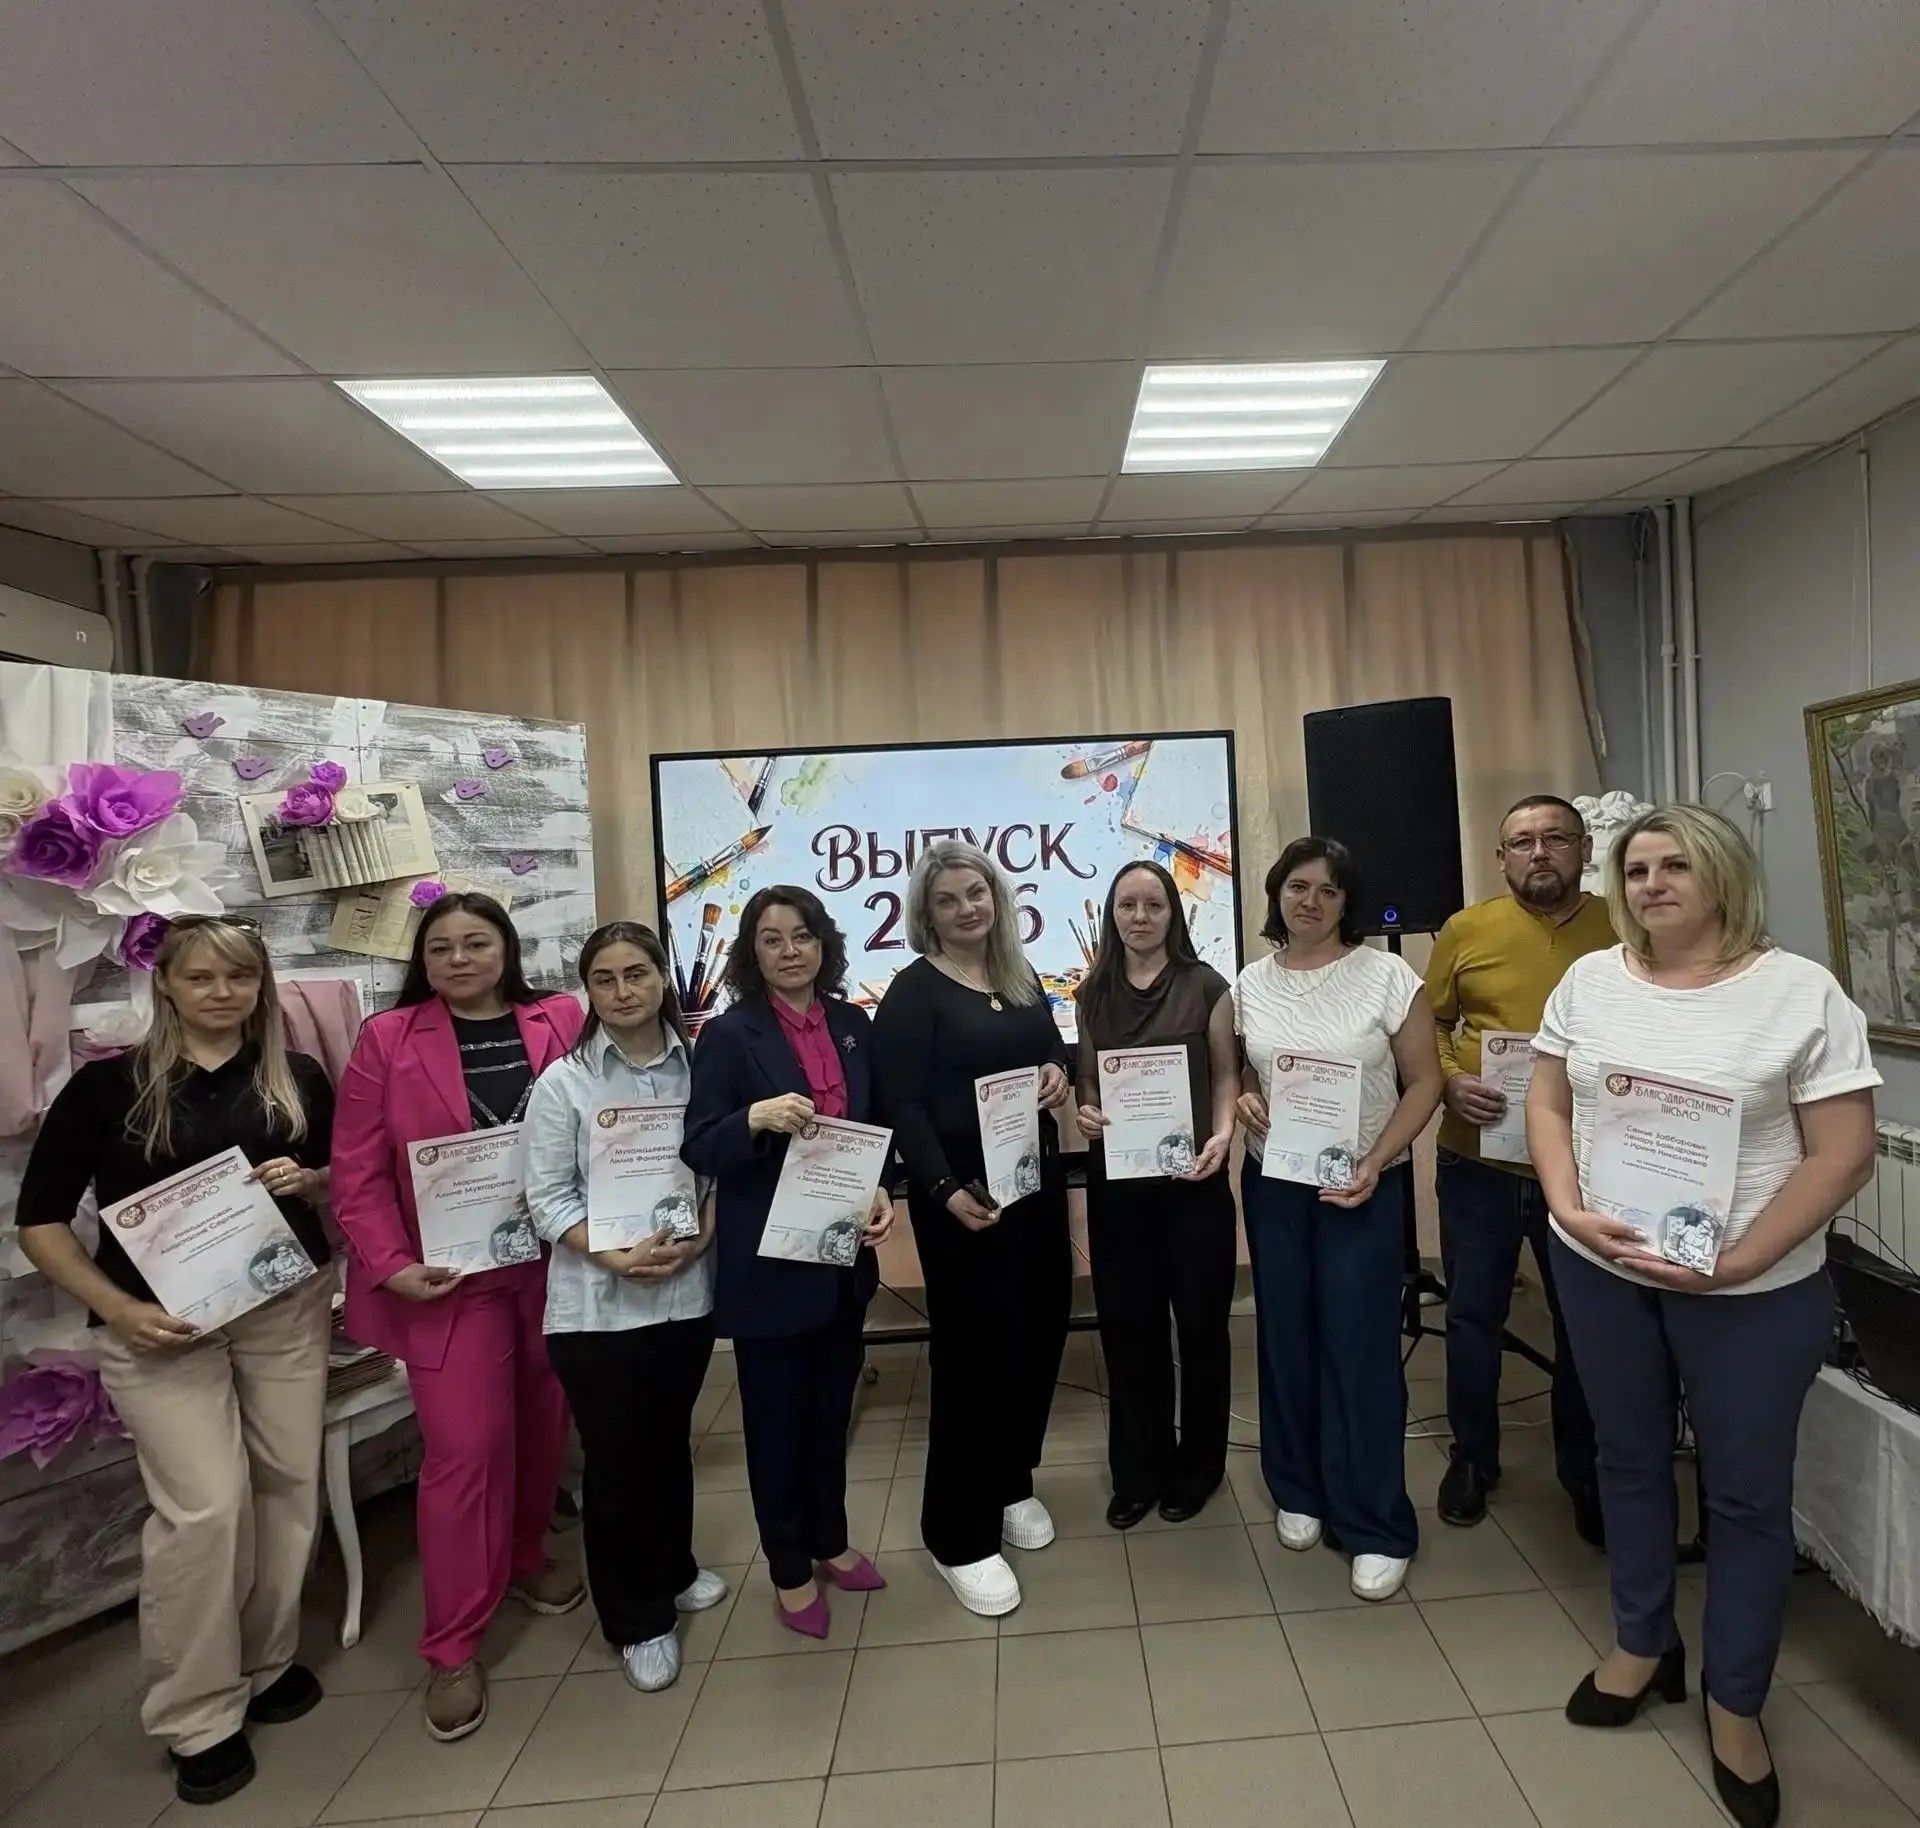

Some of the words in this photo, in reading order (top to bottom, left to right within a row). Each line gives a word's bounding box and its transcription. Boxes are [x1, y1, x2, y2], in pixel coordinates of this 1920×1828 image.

[863, 882, 1046, 952] 26
[1633, 1085, 1732, 1118] БЛАГОДАРСТВЕННОЕ
[1661, 1103, 1700, 1122] ПИСЬМО
